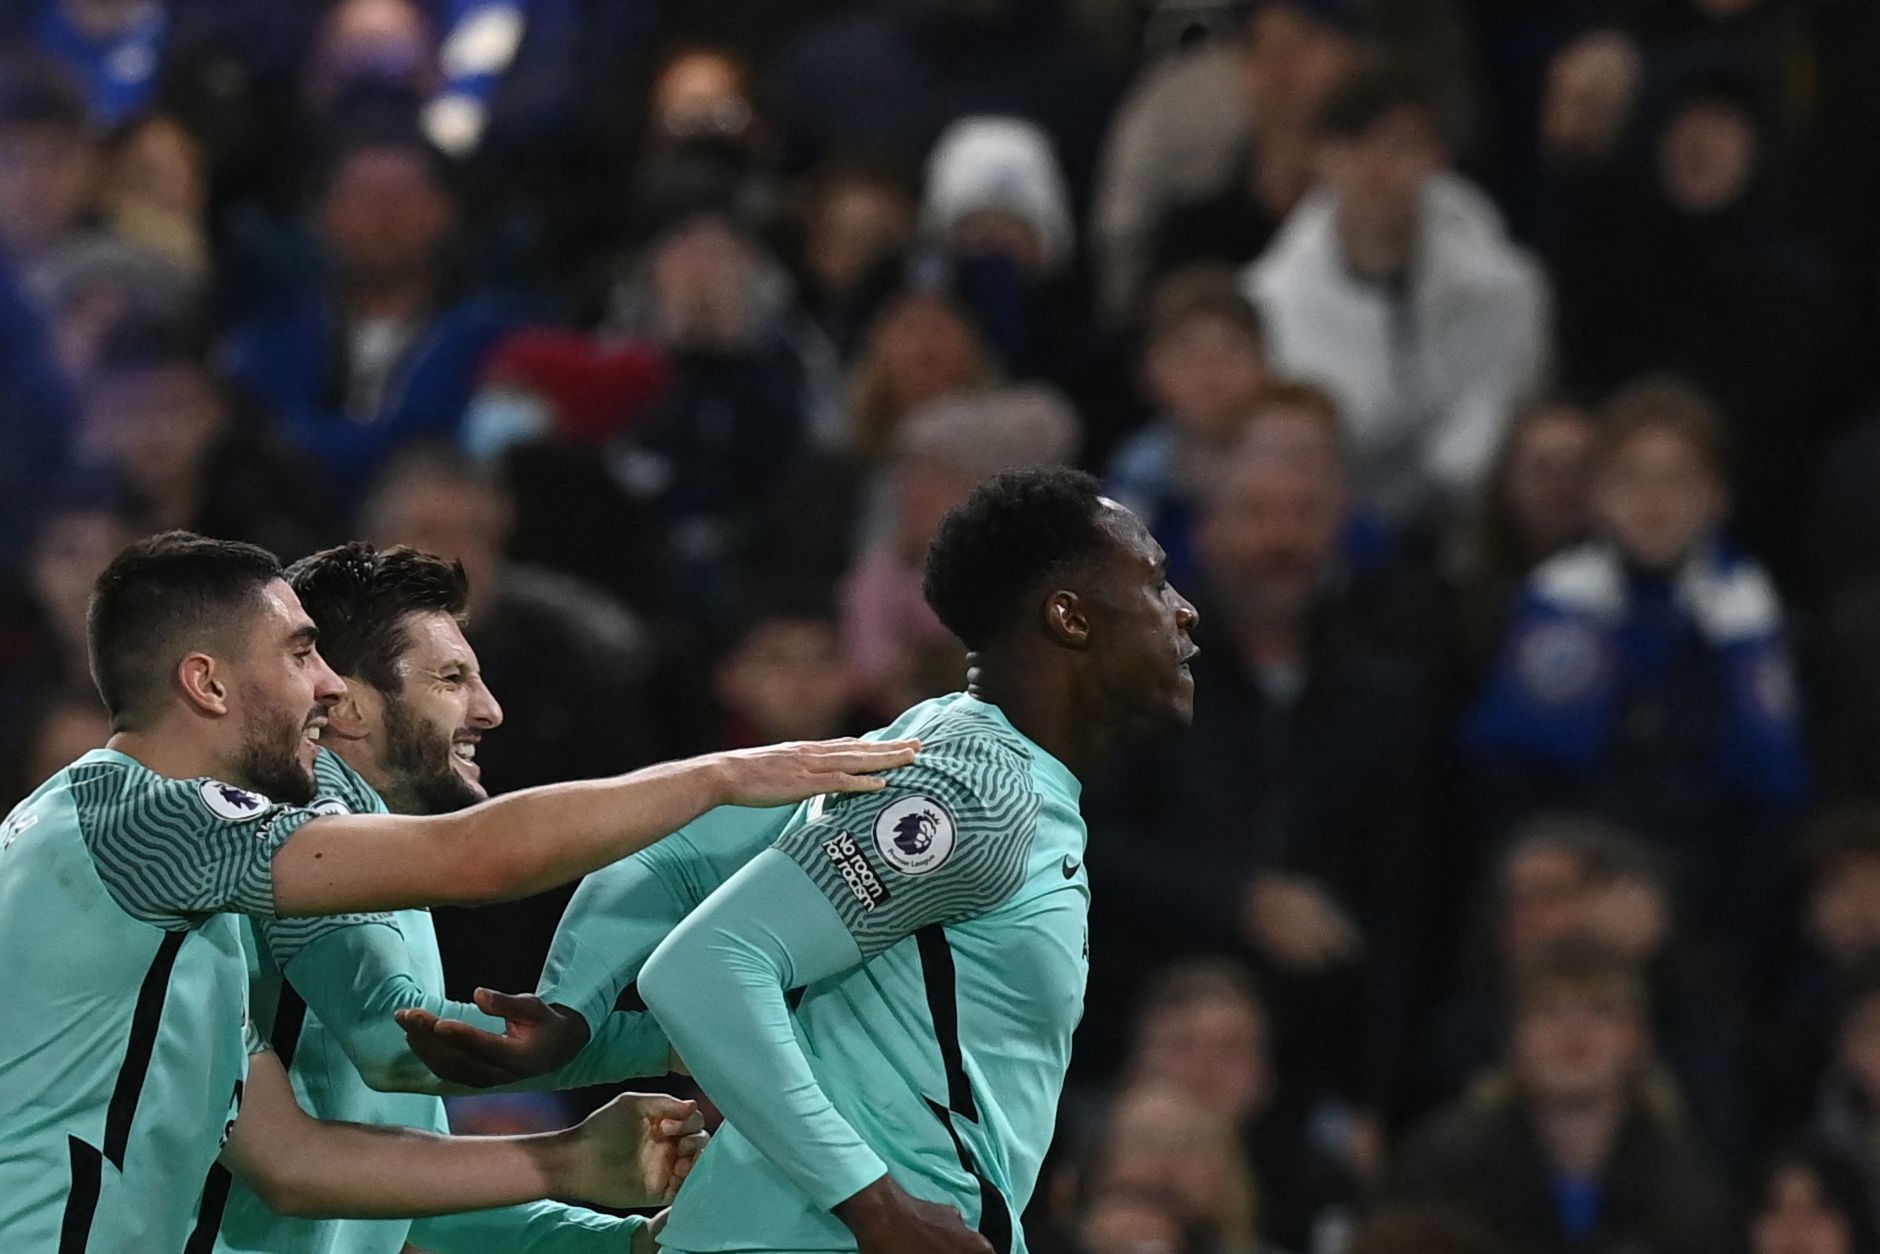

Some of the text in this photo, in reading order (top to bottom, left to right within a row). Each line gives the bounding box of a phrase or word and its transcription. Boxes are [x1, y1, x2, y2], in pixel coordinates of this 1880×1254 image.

[822, 839, 875, 912] for racism
[834, 831, 883, 898] No room
